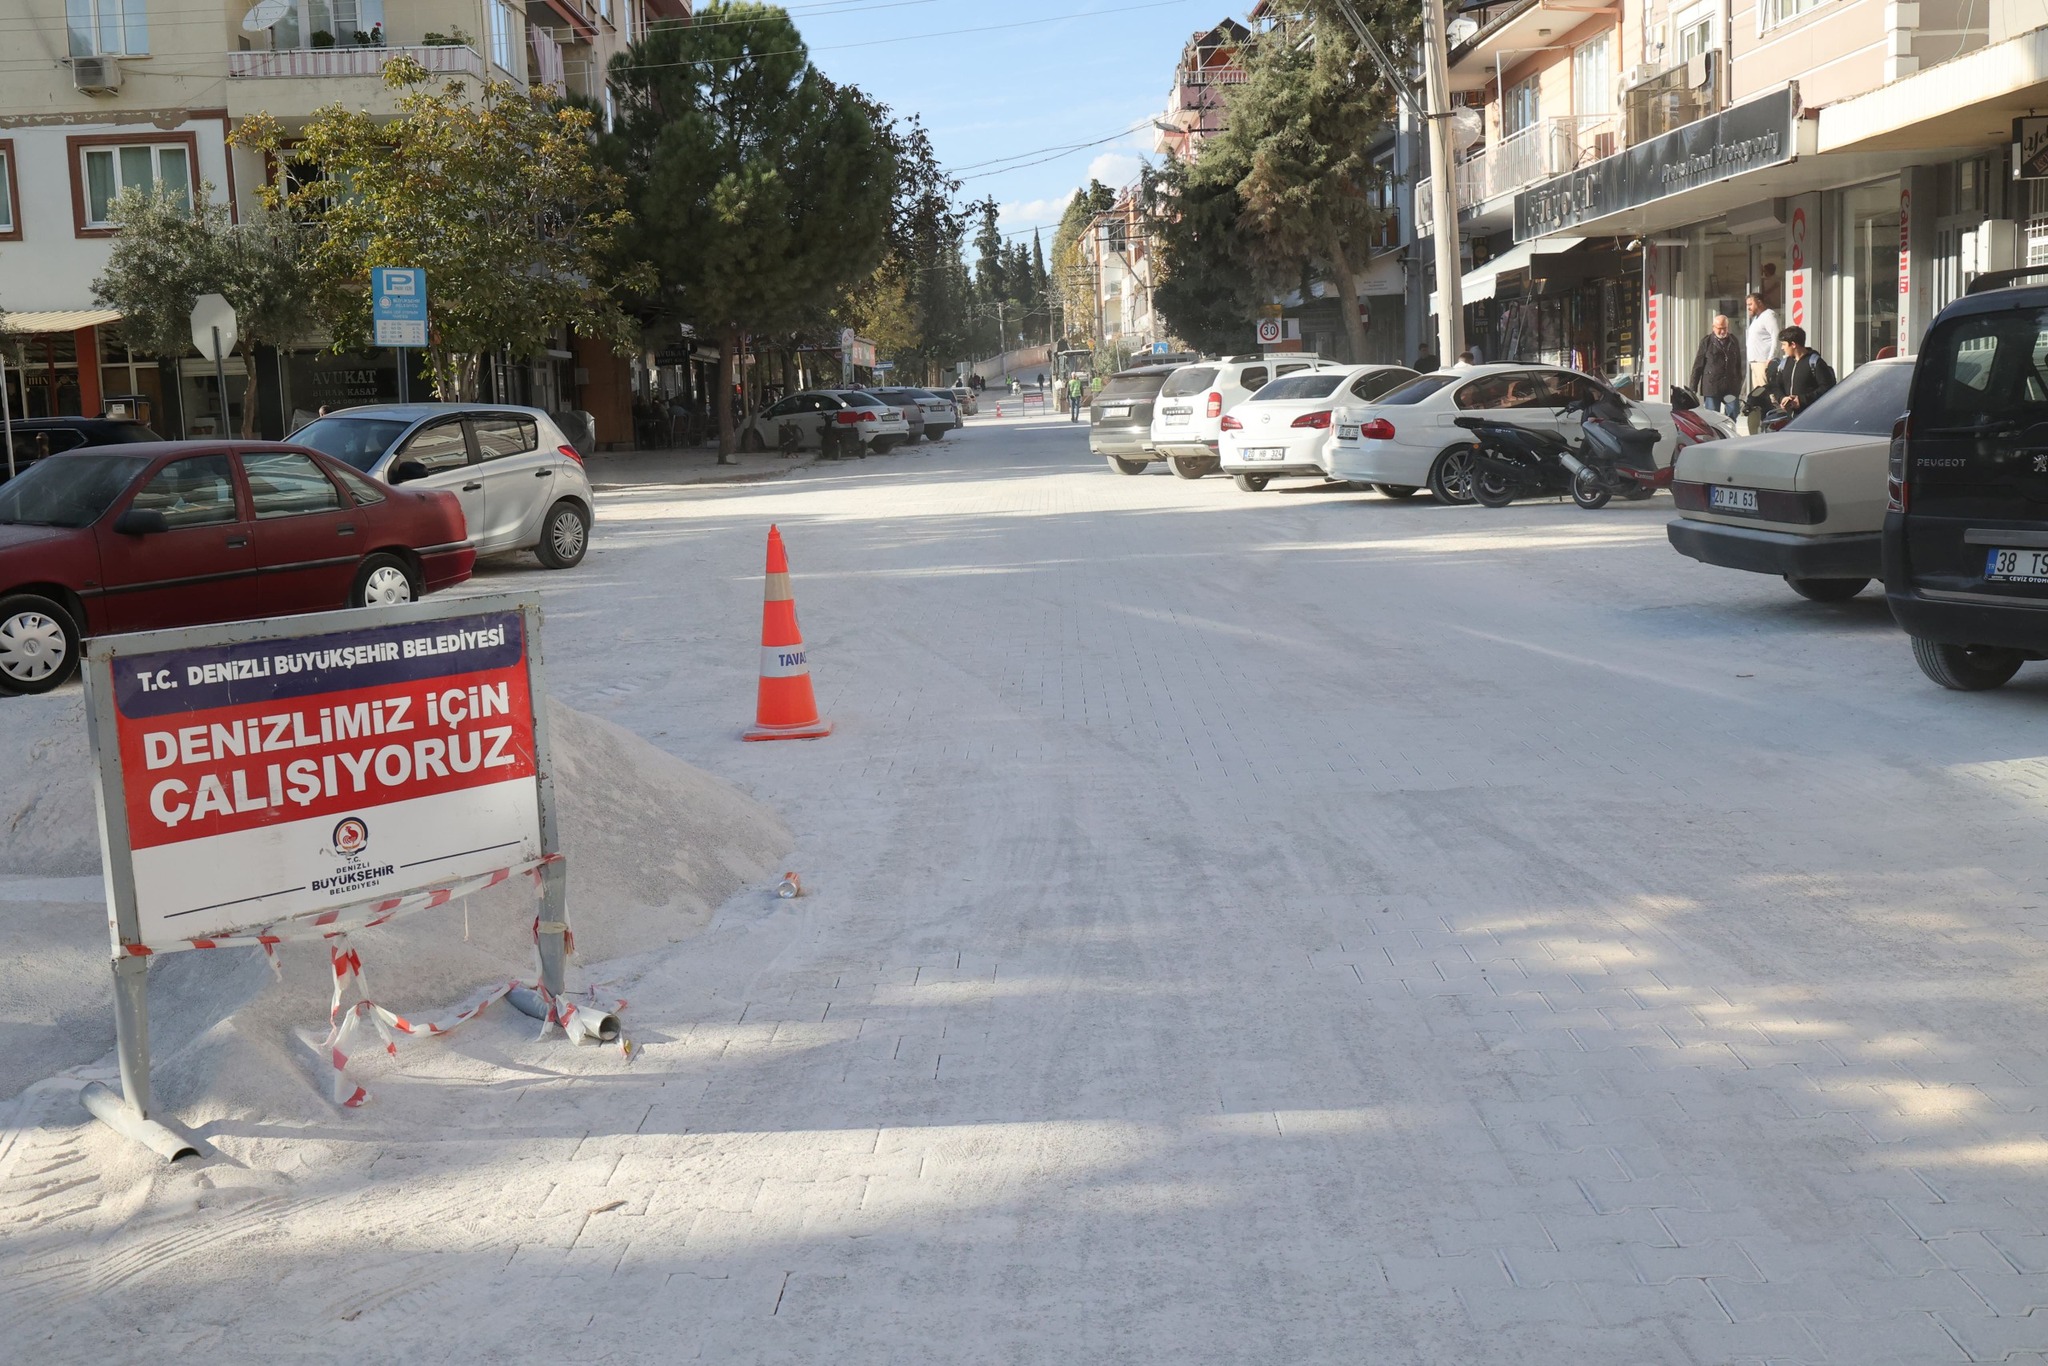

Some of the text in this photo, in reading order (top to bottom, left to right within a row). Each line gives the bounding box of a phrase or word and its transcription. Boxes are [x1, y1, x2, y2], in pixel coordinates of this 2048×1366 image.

[1901, 189, 1911, 271] Canon
[1792, 207, 1806, 326] Cano
[1264, 326, 1276, 336] 30
[312, 370, 376, 385] AVUKAT
[348, 388, 377, 396] KASAP
[1917, 459, 1966, 467] PEUGEOT
[1715, 489, 1724, 503] 20
[1729, 491, 1737, 505] PA
[1997, 552, 2017, 572] 38
[137, 670, 177, 692] T.C.
[402, 624, 505, 659] BELEDİYESİ
[150, 726, 515, 827] ÇALIŞIYORUZ
